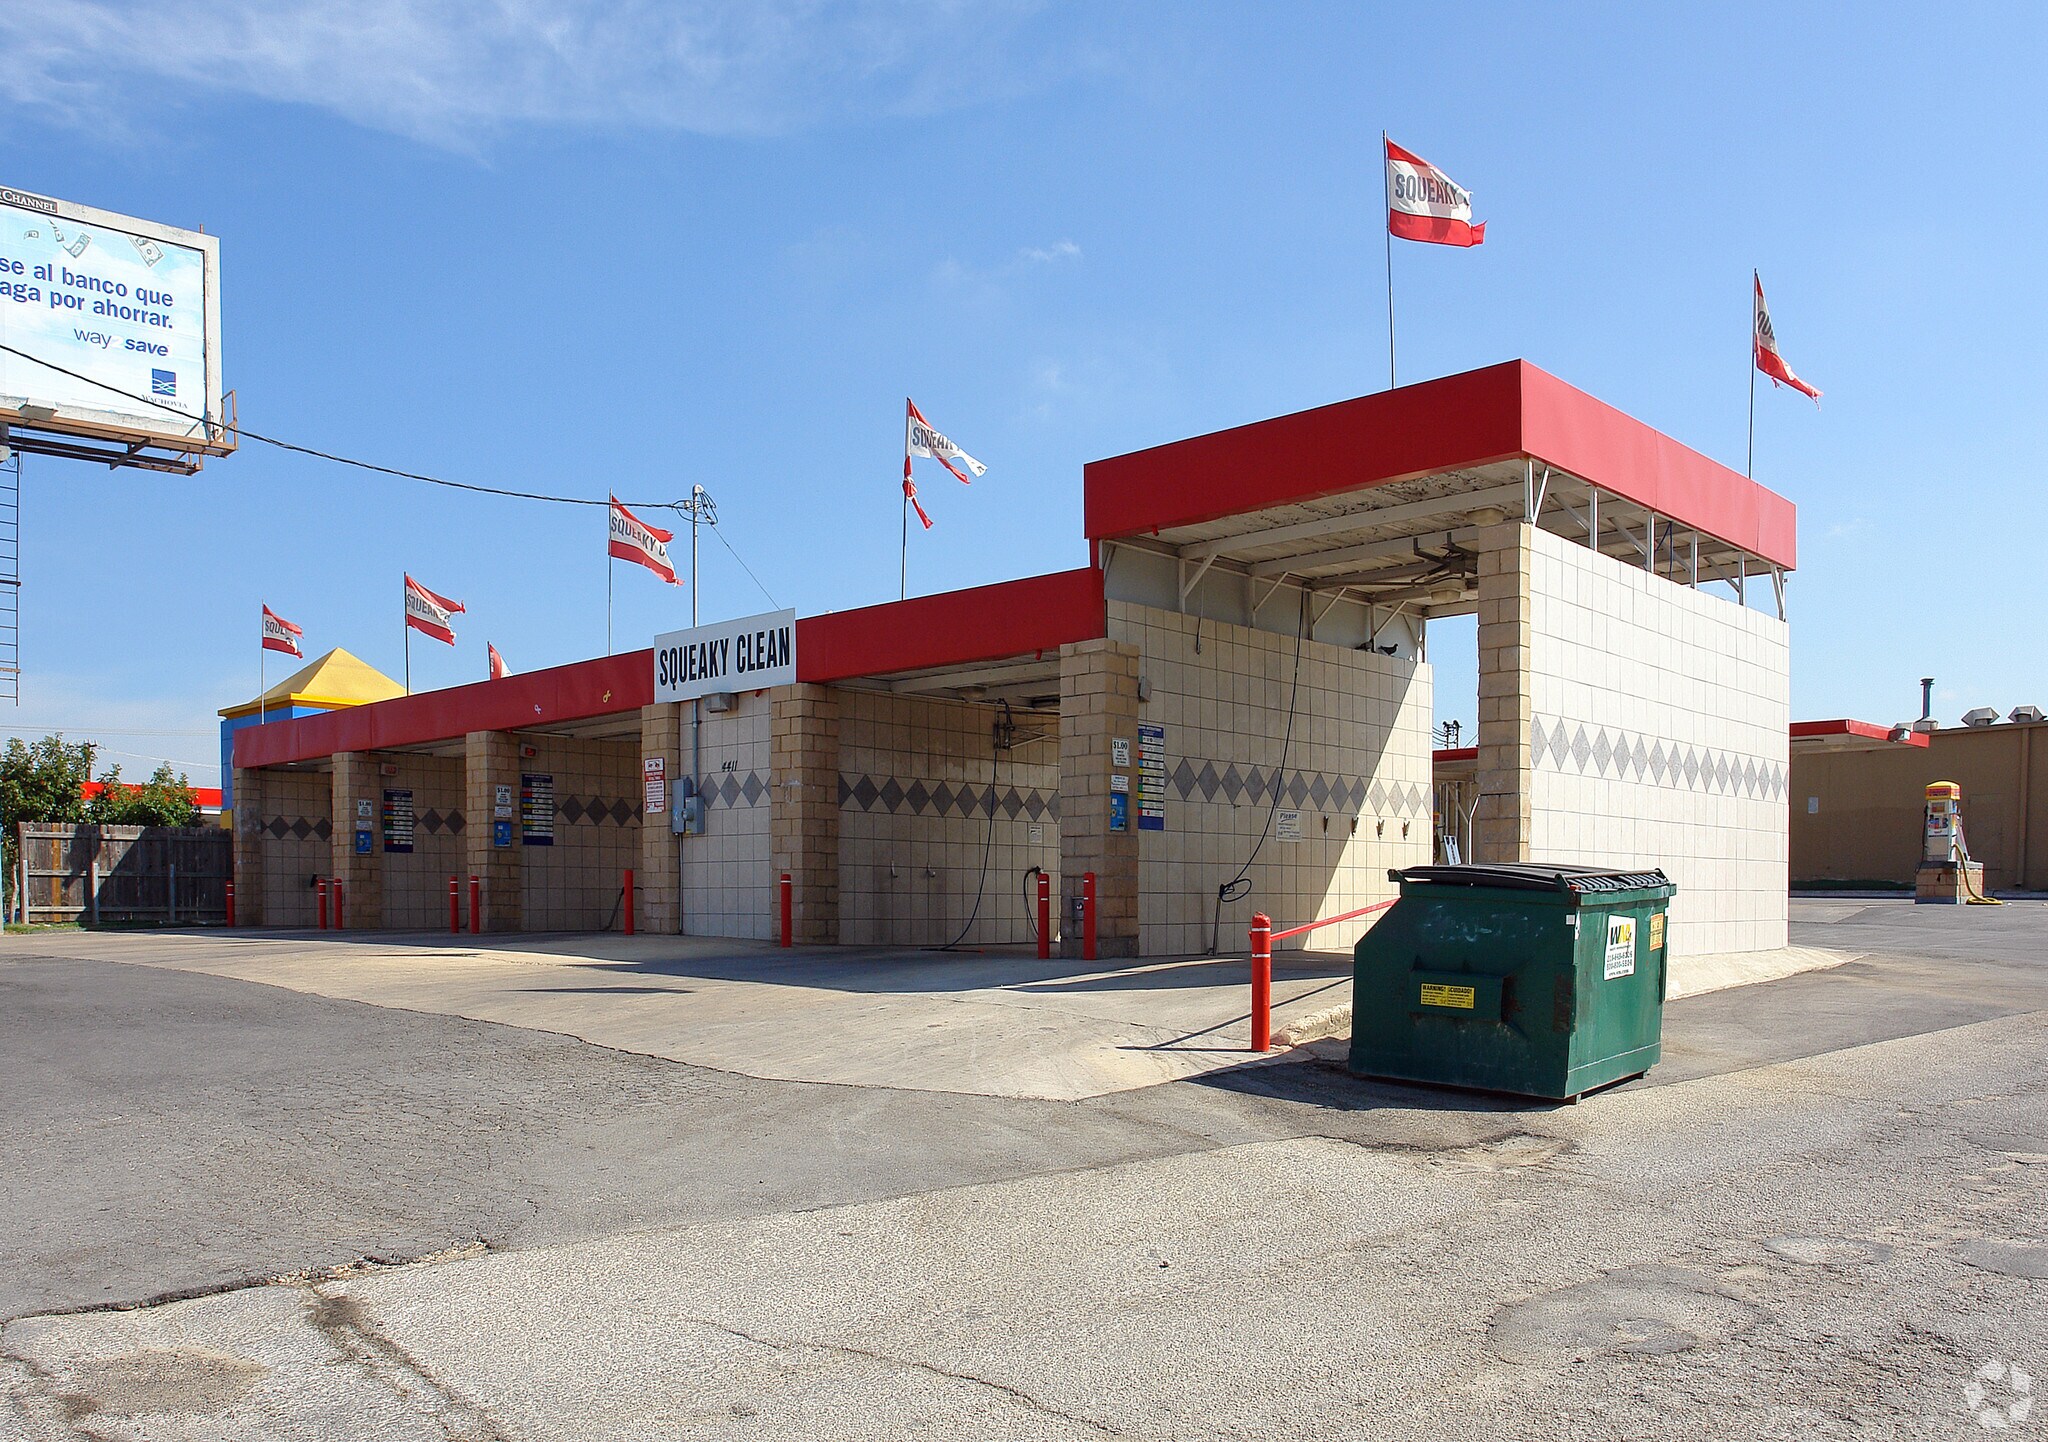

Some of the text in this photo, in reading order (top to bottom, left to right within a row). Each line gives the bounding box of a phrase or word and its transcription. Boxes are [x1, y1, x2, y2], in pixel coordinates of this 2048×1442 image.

[0, 257, 174, 307] se al banco que
[0, 281, 173, 329] aga por ahorrar.
[659, 626, 790, 691] SQUEAKY CLEAN
[721, 759, 738, 773] 4411
